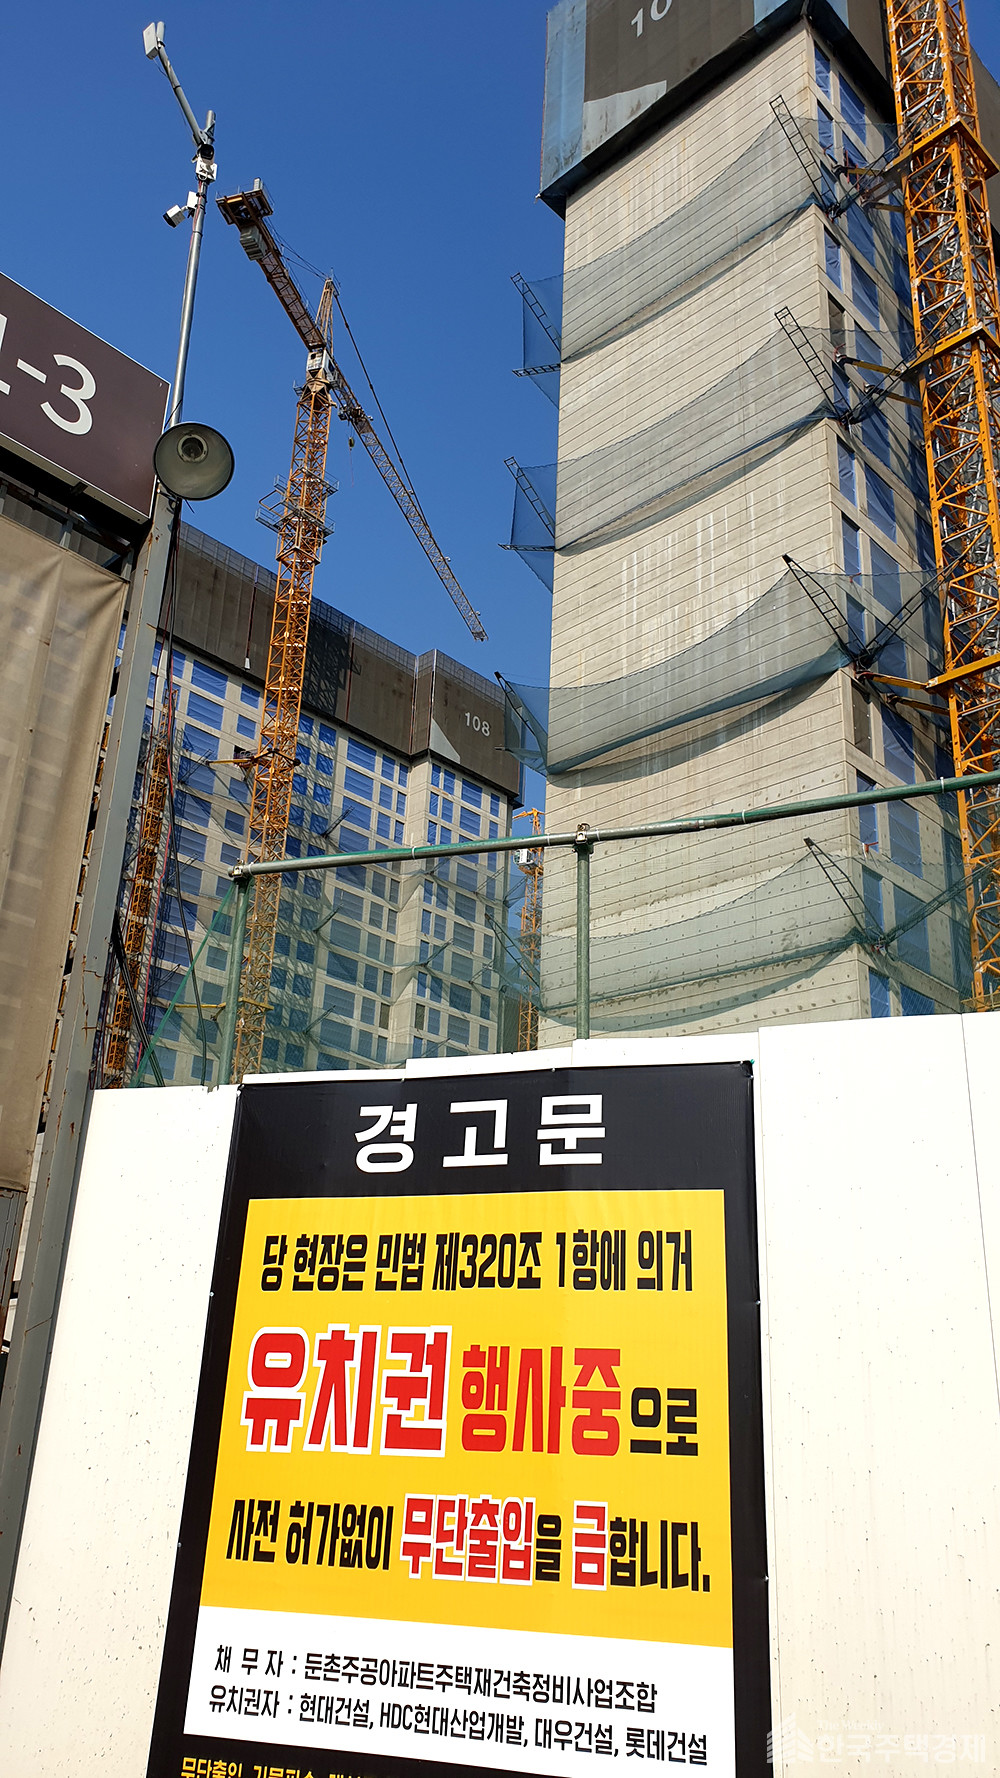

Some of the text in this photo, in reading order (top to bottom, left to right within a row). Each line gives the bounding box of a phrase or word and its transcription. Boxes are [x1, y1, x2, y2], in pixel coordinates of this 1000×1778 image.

[464, 712, 491, 737] 108
[261, 1229, 693, 1292] 당 현장은 민법 제320조 1항에 의거
[241, 1324, 453, 1457] 유치권
[226, 1493, 711, 1592] 사전 허가없이 무단출입을 금합니다.
[304, 1652, 657, 1713] 둔촌주공아파트주택재건축정비사업조합
[209, 1684, 280, 1718] 유치권자
[299, 1692, 374, 1730] 현대건설,
[379, 1702, 528, 1748] HDC현대산업개발,
[534, 1718, 619, 1757] 대우건설,
[625, 1726, 707, 1766] 롯데건설
